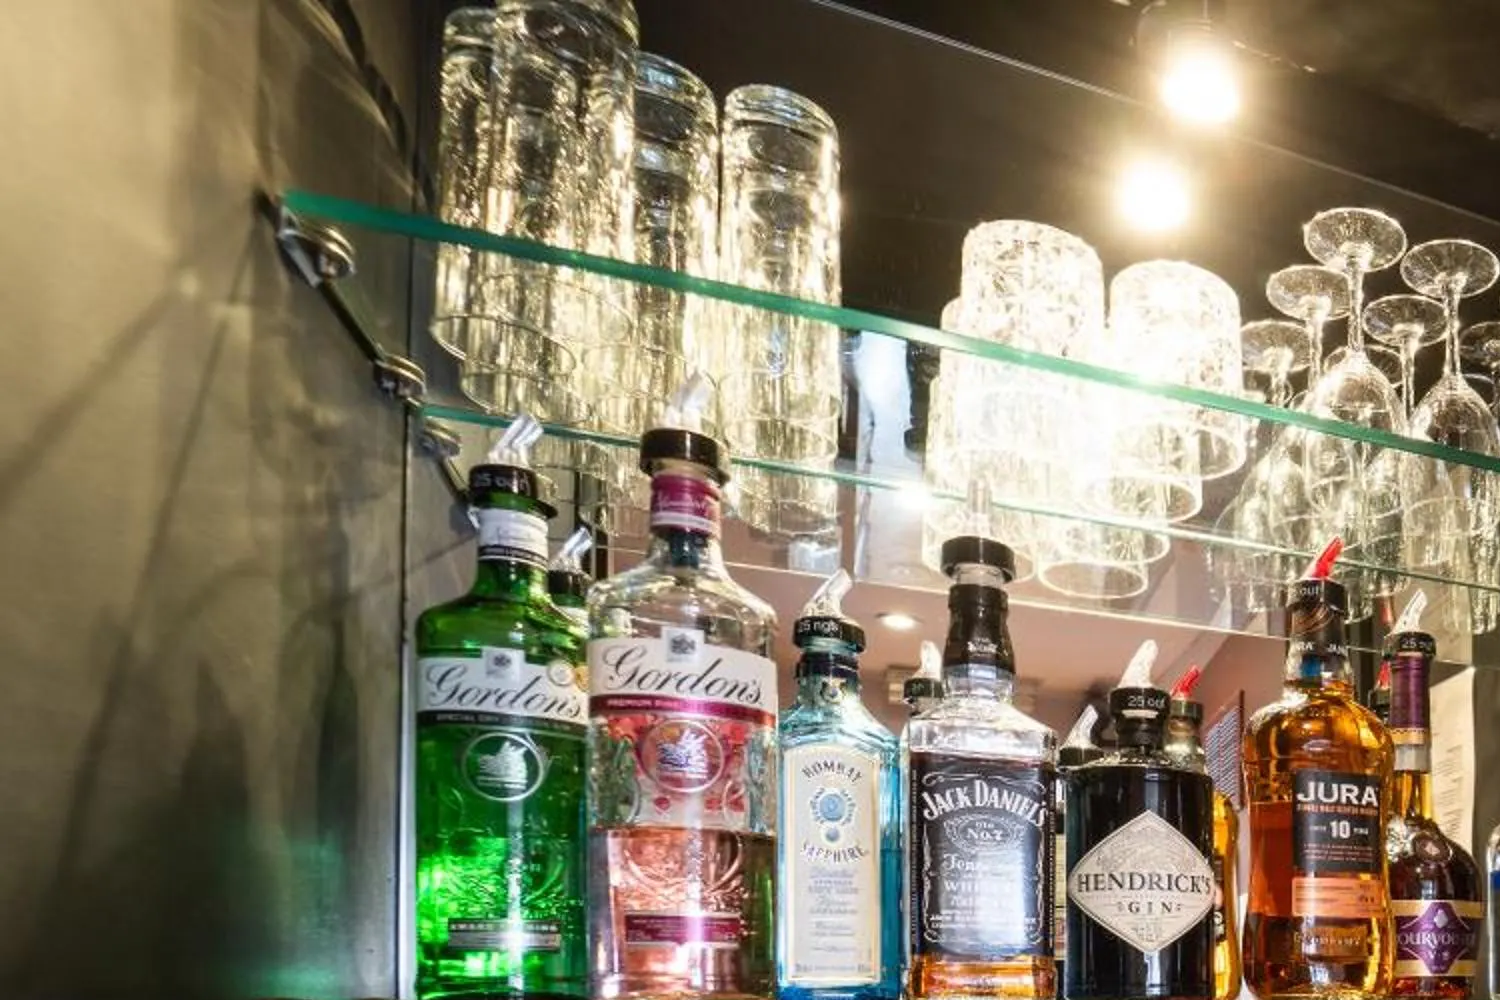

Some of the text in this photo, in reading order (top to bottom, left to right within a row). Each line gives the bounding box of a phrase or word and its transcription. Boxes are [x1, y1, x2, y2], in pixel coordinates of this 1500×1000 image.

[603, 645, 763, 705] Gordon's
[427, 664, 582, 718] Gordon's
[921, 779, 1049, 827] JACK DANIEL'S
[1296, 781, 1379, 807] JURA
[1330, 820, 1351, 839] 10
[1077, 871, 1211, 895] HENDRICK'S
[1127, 901, 1173, 914] GIN
